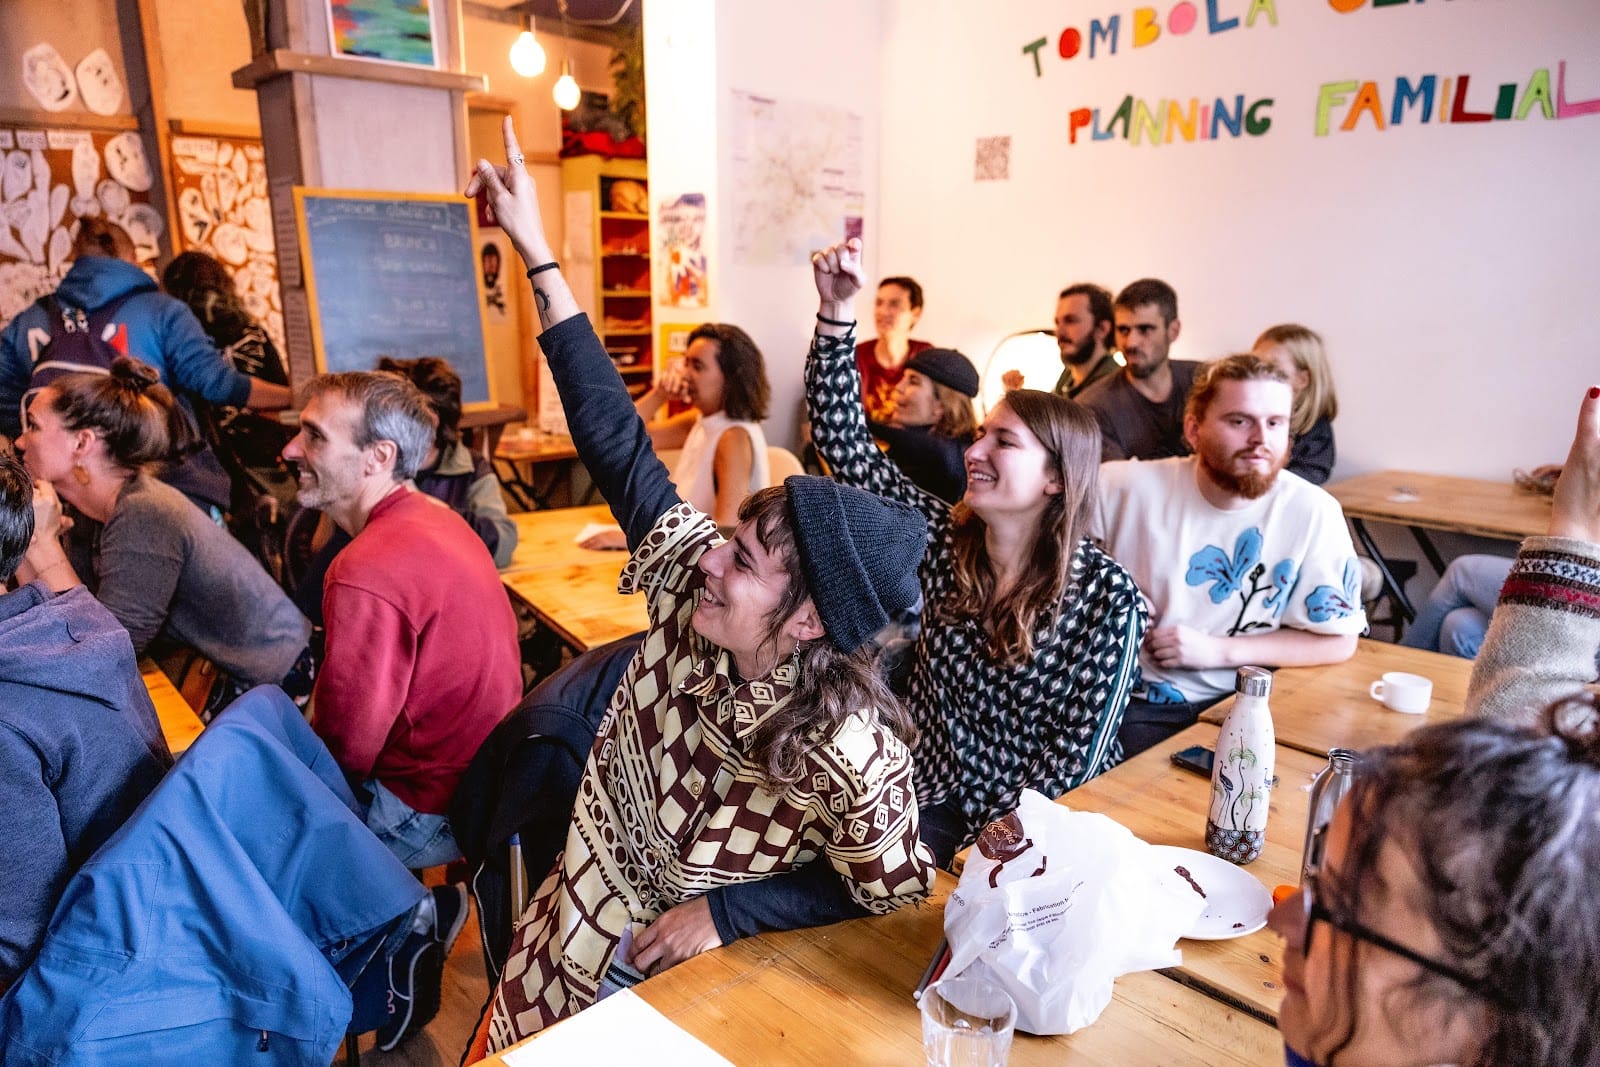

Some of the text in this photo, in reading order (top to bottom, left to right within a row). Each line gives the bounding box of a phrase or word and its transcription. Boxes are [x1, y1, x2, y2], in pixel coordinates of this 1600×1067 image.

[1023, 0, 1278, 77] TOMBOLA
[1069, 60, 1600, 146] PLANNING FAMILIAL
